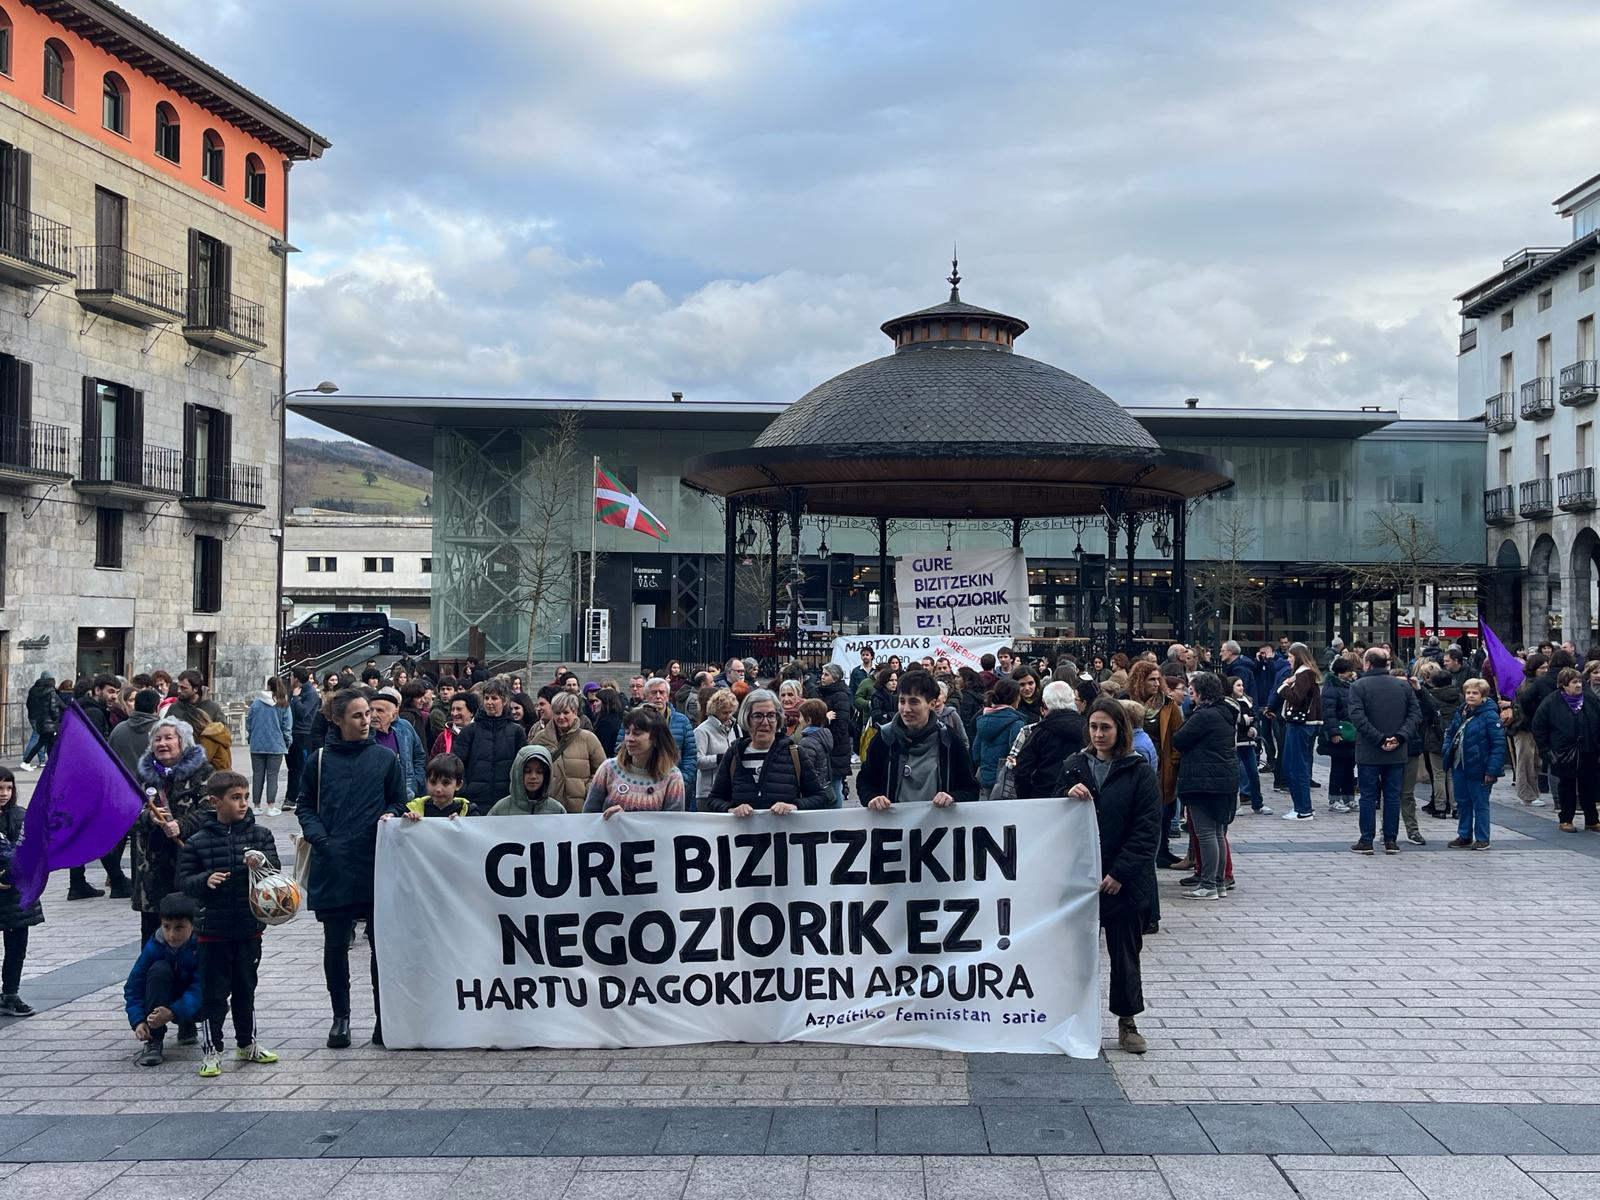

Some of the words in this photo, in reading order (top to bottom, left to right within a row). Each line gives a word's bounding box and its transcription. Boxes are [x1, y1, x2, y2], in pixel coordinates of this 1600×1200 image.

[912, 557, 953, 572] GURE
[914, 573, 993, 592] BIZITZEKIN
[915, 590, 1008, 609] NEGOZIORIK
[975, 614, 1010, 625] HARTU
[943, 625, 1010, 637] DAGOKIZUEN
[845, 638, 919, 652] MARTXOAK
[922, 637, 930, 649] 8
[485, 840, 658, 899] GURE
[673, 825, 1017, 894] BIZITZEKIN
[498, 899, 893, 969] NEGOZIORIK
[456, 976, 588, 1011] HARTU
[598, 967, 855, 1010] DAGOKIZUEN
[865, 963, 1034, 1002] ARDURA
[805, 1008, 886, 1028] Azpeitiko
[895, 1007, 991, 1023] feministan
[1003, 1009, 1047, 1025] sarie
